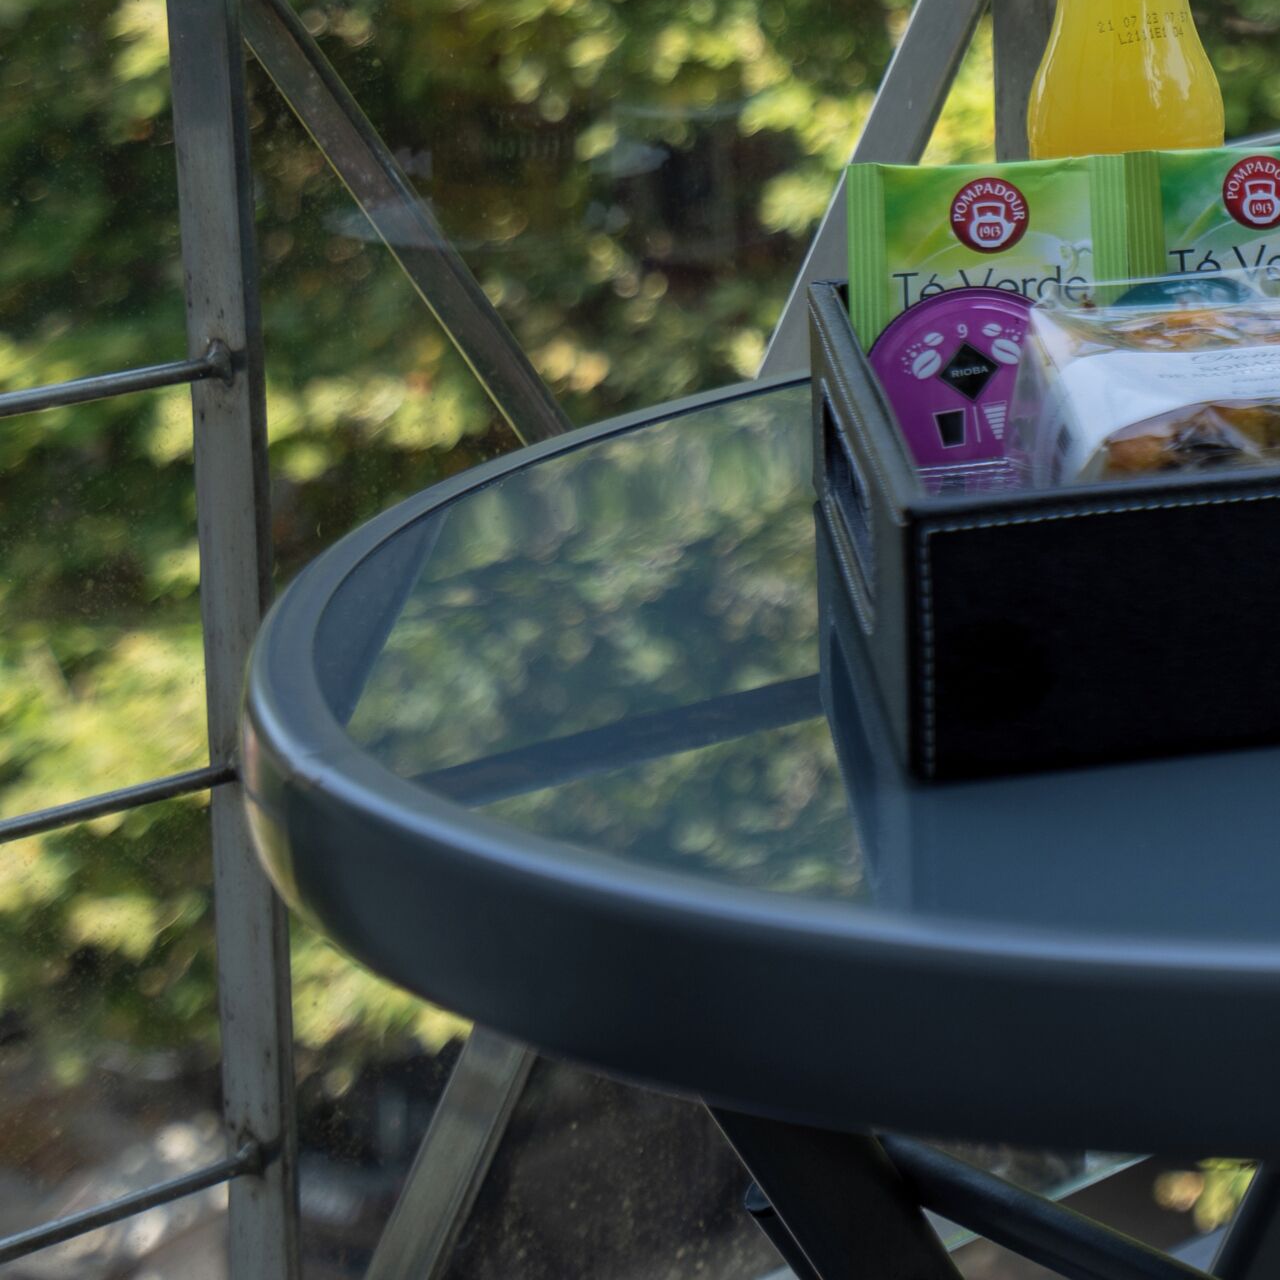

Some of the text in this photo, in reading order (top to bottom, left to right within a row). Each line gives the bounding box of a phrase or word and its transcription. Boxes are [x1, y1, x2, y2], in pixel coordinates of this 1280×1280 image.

[1123, 16, 1137, 28] 07
[954, 182, 1025, 222] POMPADOUR
[1251, 201, 1273, 214] 1913
[979, 225, 1002, 238] 1913
[1169, 247, 1222, 271] Té
[893, 272, 945, 308] Té
[956, 323, 968, 339] 9
[951, 365, 989, 379] RIOBA
